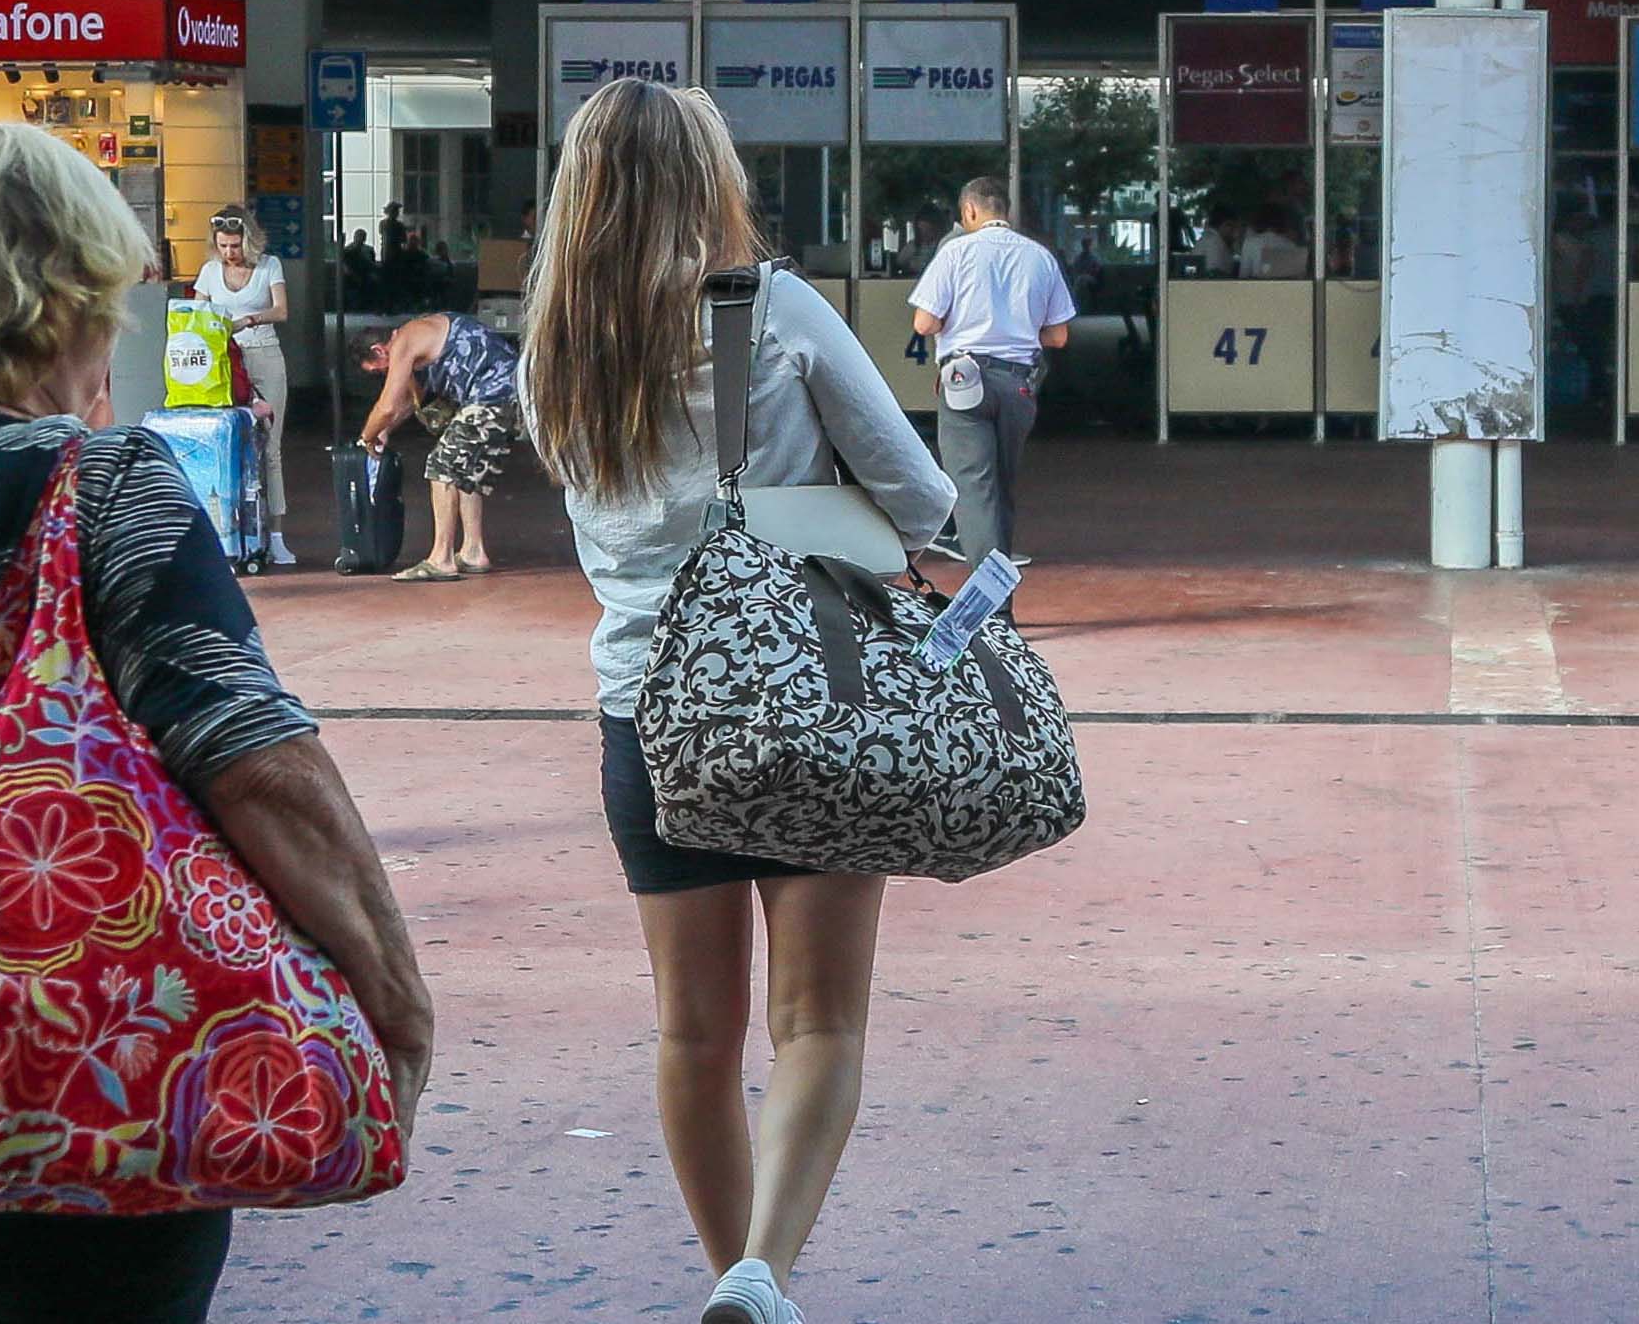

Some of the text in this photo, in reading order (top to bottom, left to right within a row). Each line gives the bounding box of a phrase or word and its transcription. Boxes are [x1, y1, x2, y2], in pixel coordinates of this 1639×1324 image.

[190, 14, 240, 48] vodafone
[612, 60, 678, 83] PEGAS
[771, 66, 836, 88] PEGAS
[928, 66, 994, 91] PEGAS
[1178, 62, 1302, 89] Pegas Select
[1213, 327, 1268, 366] 47
